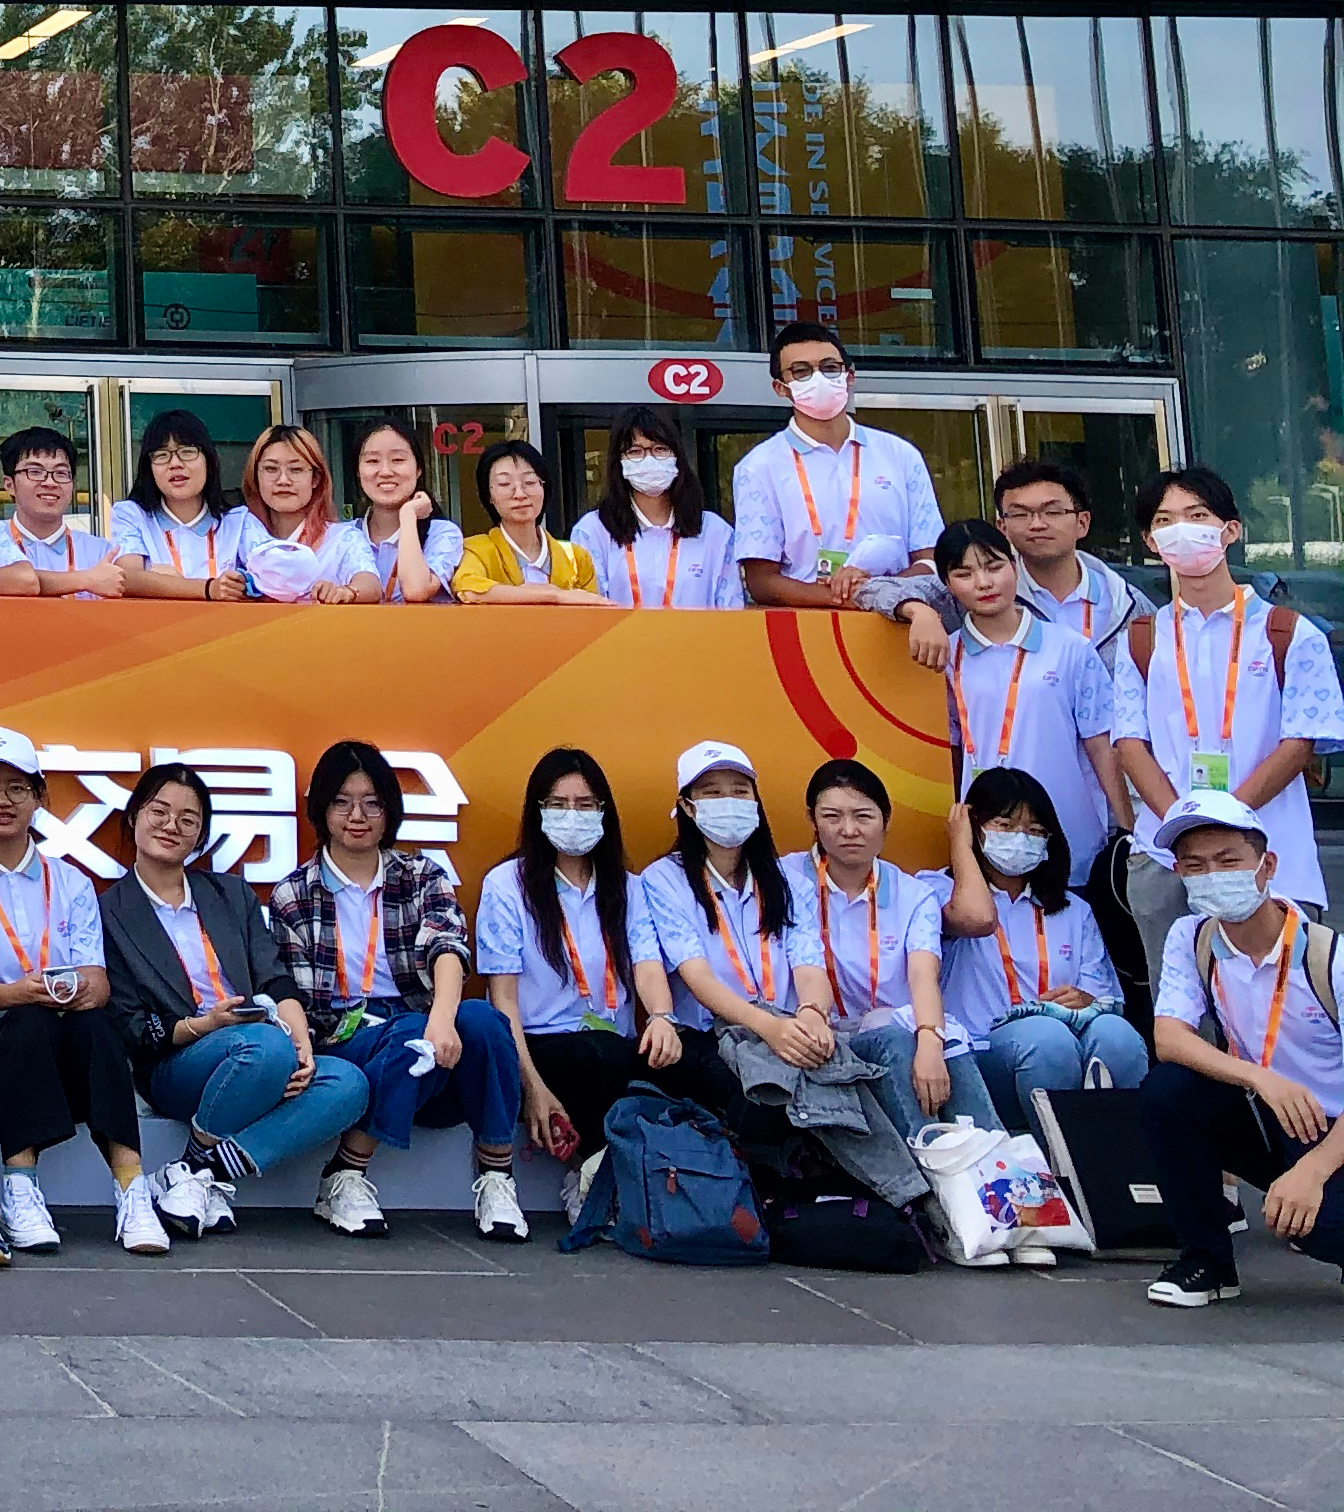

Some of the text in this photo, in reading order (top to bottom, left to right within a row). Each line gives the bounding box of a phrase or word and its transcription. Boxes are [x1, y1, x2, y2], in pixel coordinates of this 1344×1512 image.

[382, 24, 687, 204] C2
[805, 133, 827, 171] IN
[809, 180, 841, 338] SEVICE
[663, 364, 711, 396] C2
[432, 421, 486, 455] C2
